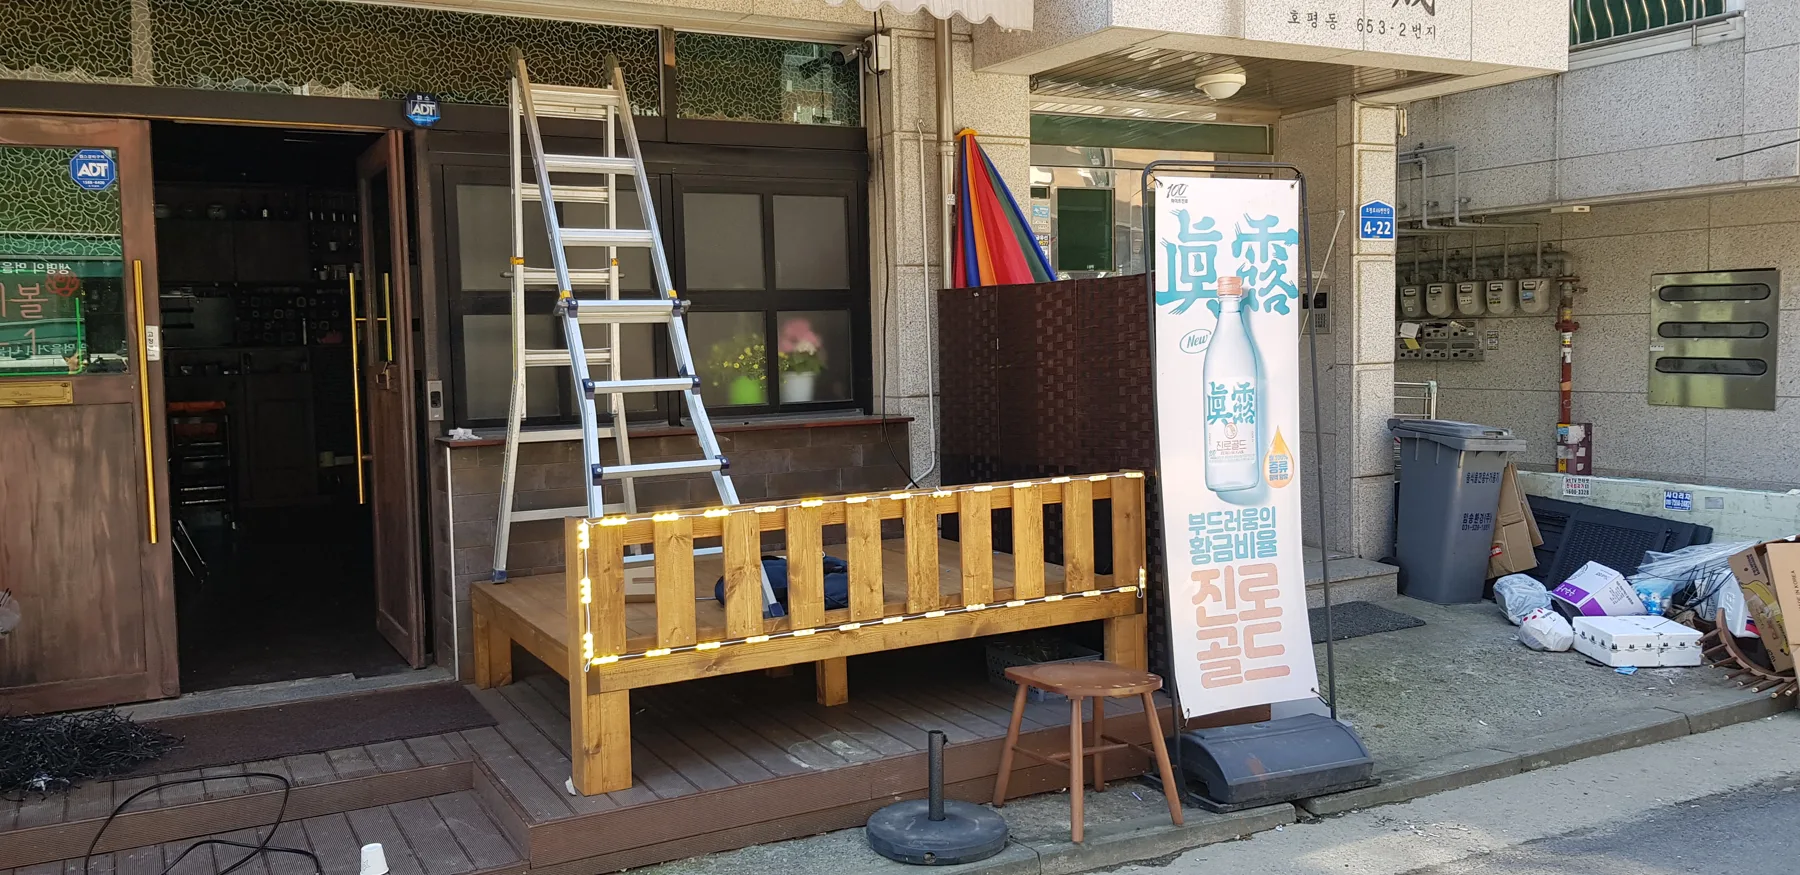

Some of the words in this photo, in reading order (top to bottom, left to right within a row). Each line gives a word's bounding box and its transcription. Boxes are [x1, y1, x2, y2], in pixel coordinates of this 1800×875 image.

[1287, 9, 1338, 30] 호평동
[411, 103, 436, 116] ADT
[77, 162, 109, 178] ADT
[1363, 220, 1391, 236] 4-22
[1186, 333, 1209, 350] New
[1216, 439, 1248, 452] 진로골드
[1268, 460, 1289, 474] 증류
[1665, 491, 1691, 500] 사다리차
[1188, 505, 1276, 536] 부드러움의
[1188, 529, 1278, 566] 황금비율
[1190, 562, 1284, 628] 진로
[1196, 620, 1291, 690] 골드
